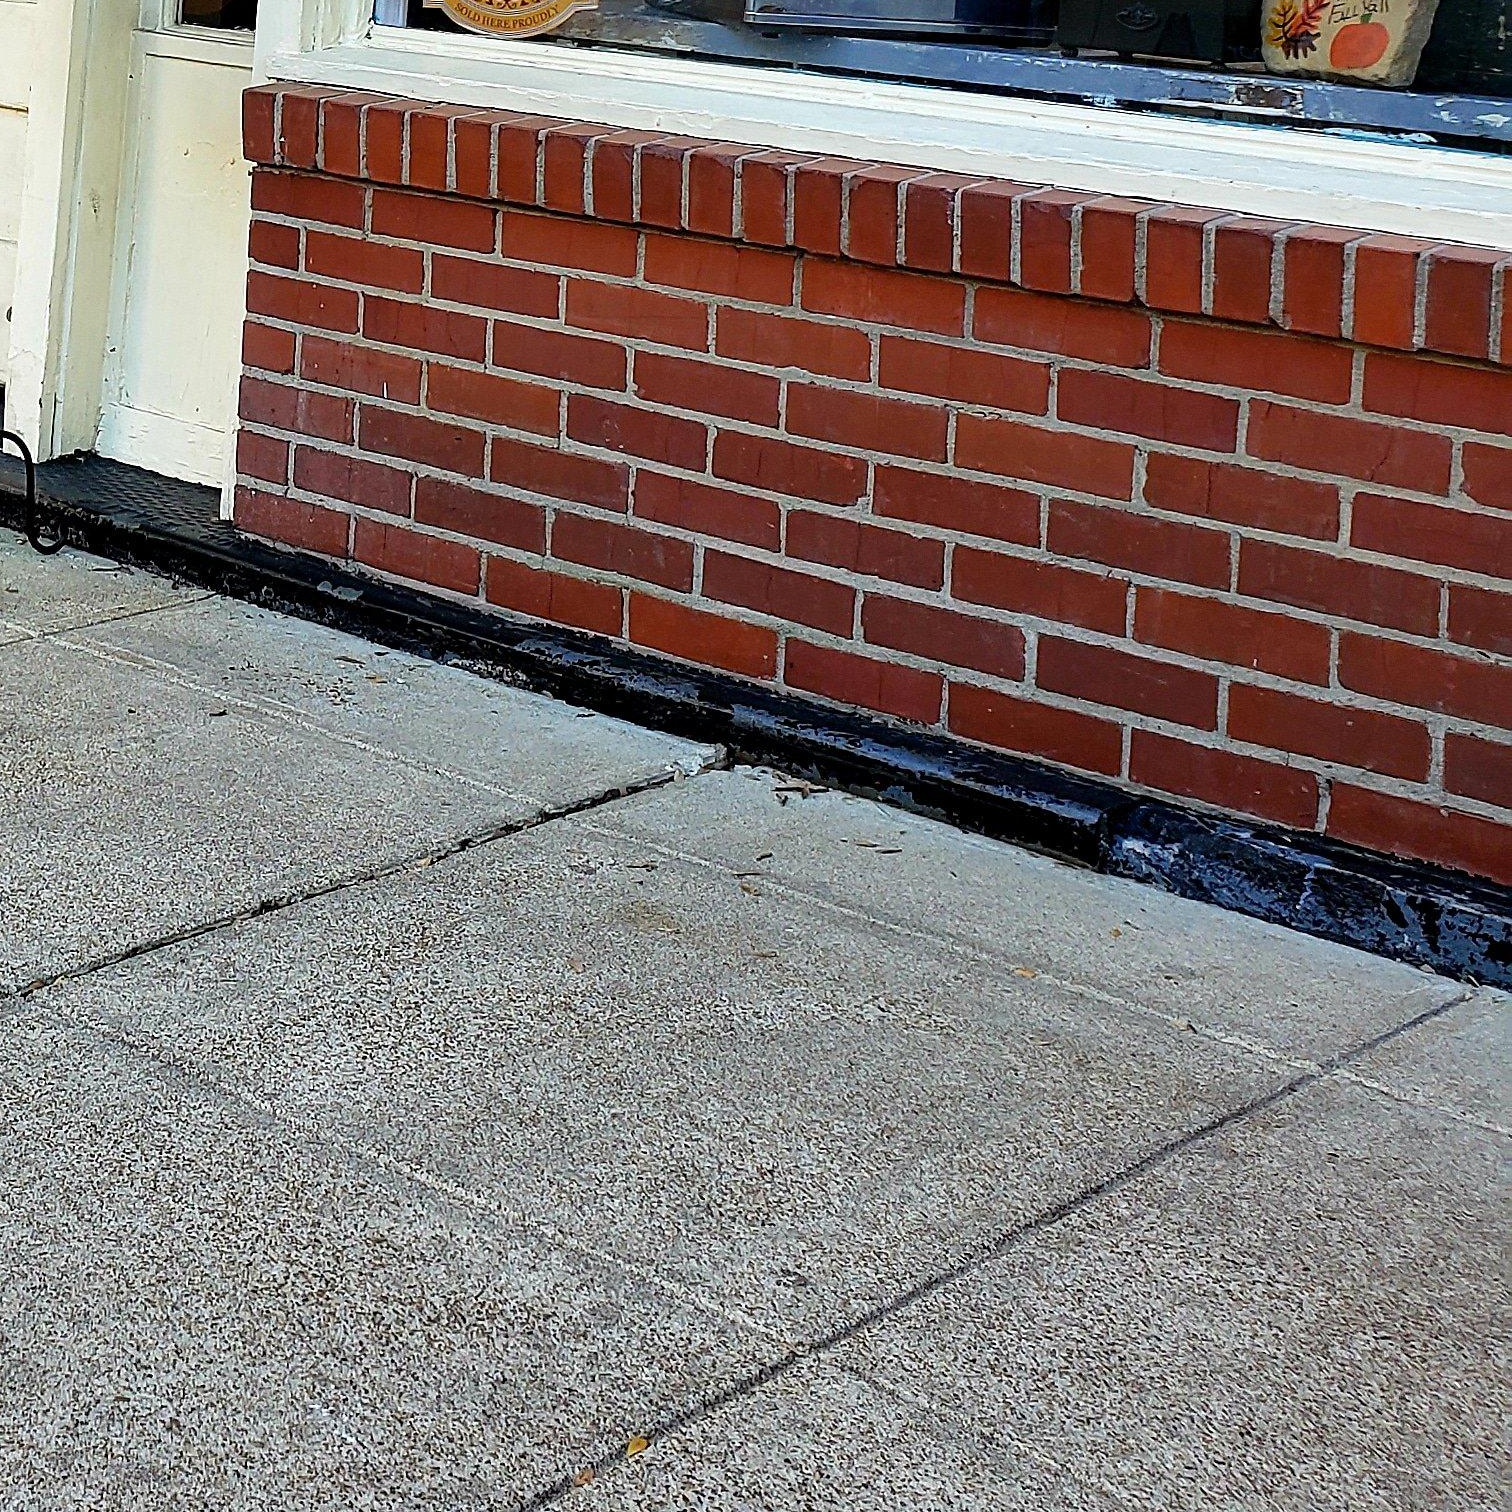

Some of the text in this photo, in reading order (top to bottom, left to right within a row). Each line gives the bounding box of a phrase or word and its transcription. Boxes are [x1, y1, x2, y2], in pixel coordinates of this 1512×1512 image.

[455, 2, 560, 29] SOLD HERE PROUDLY
